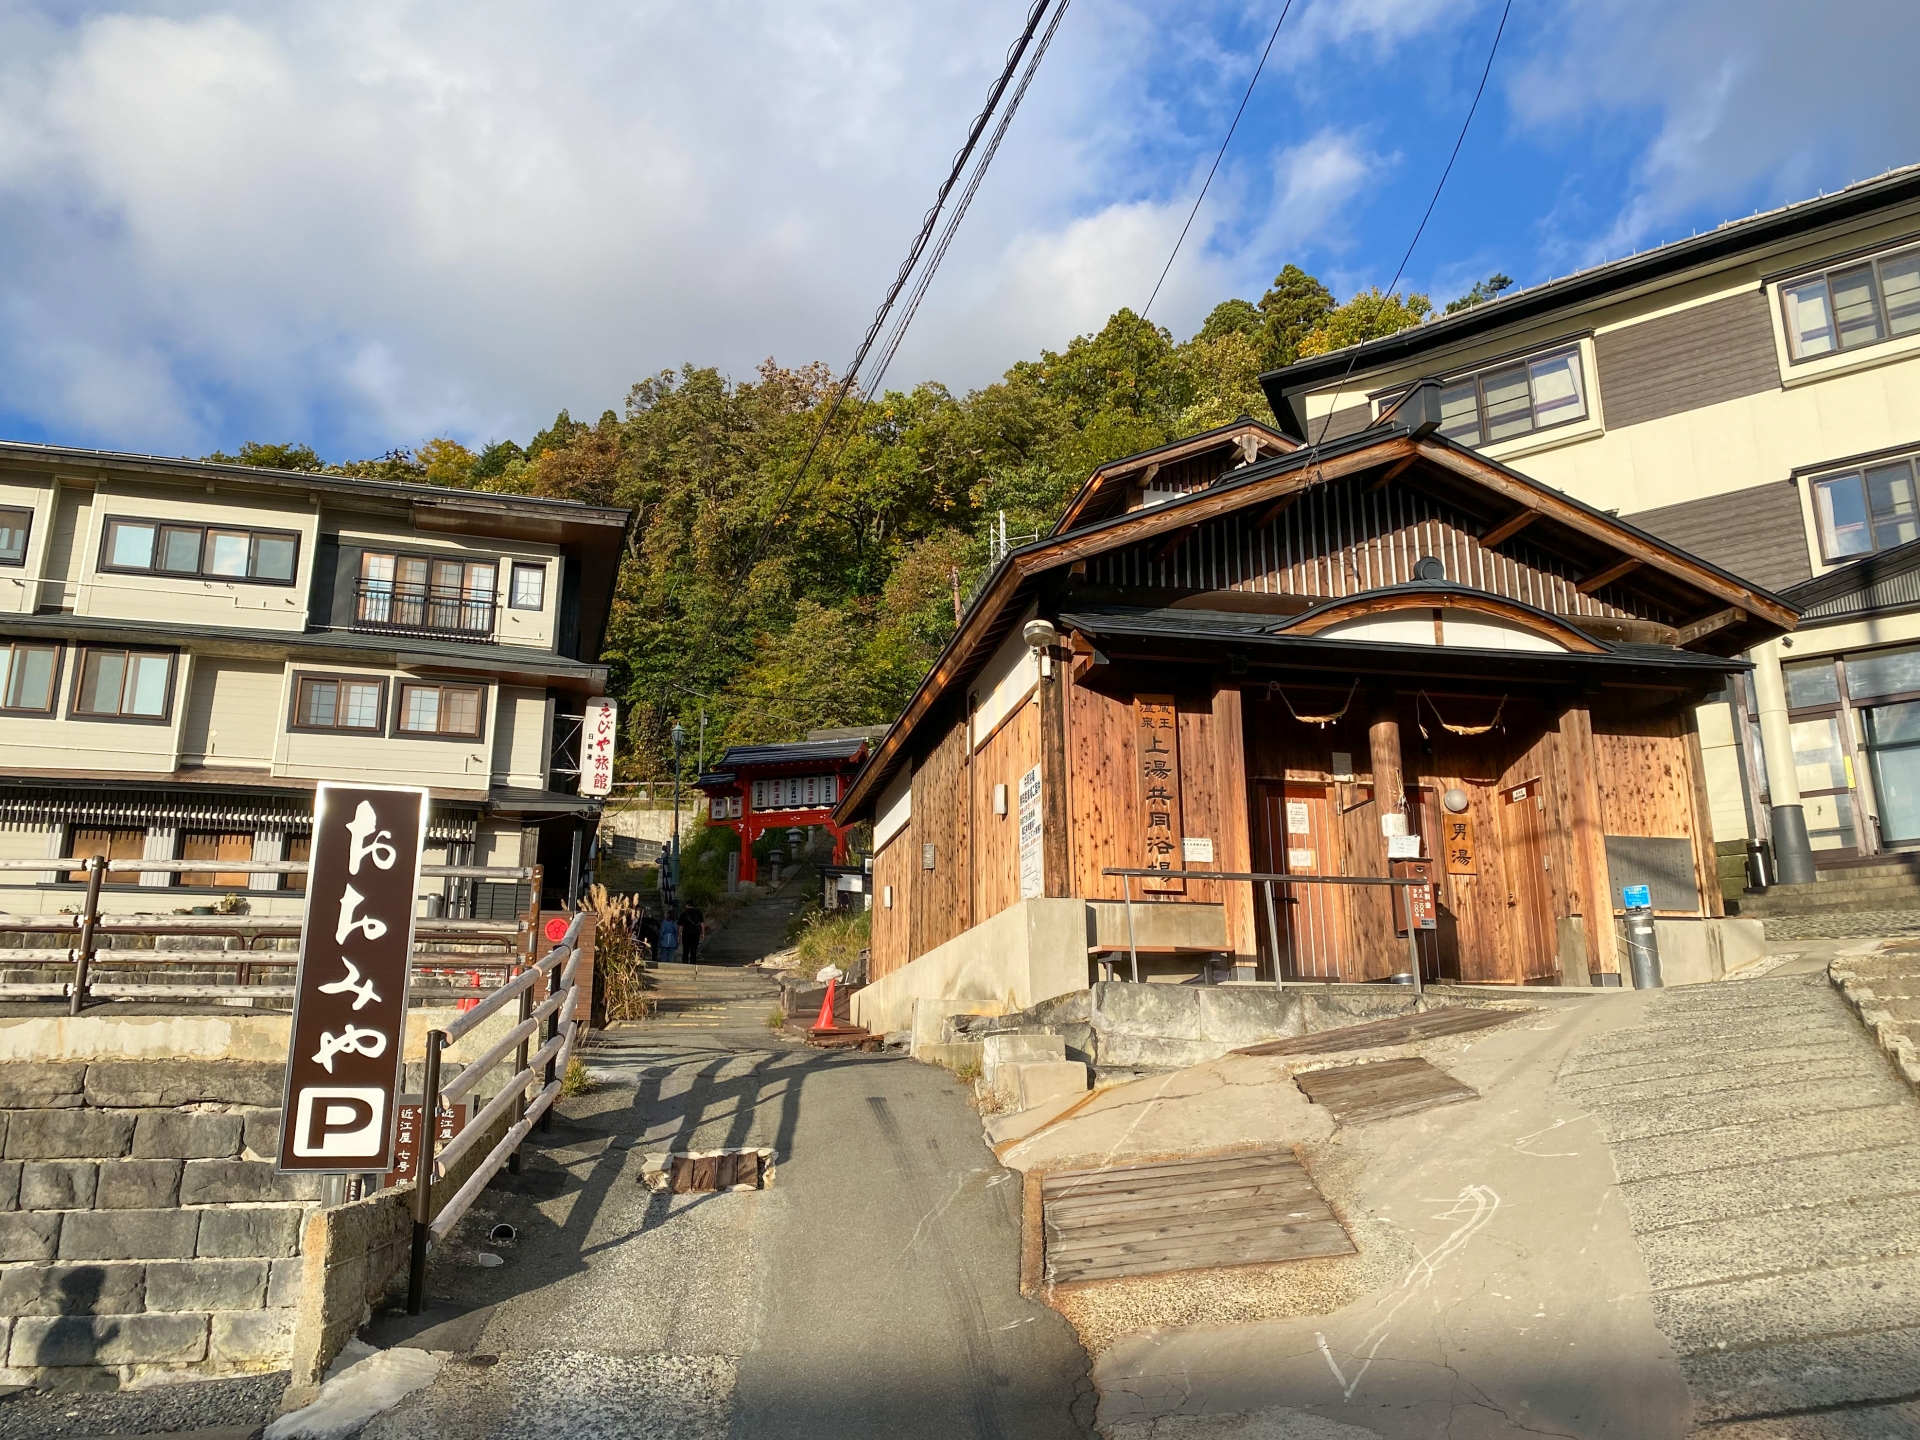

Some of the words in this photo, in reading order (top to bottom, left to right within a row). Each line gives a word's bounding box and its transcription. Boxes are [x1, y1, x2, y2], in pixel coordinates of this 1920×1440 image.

[593, 702, 613, 789] えびや旅館
[1451, 823, 1472, 866] 男湯
[307, 1097, 373, 1149] P
[399, 1108, 414, 1143] 近江屋
